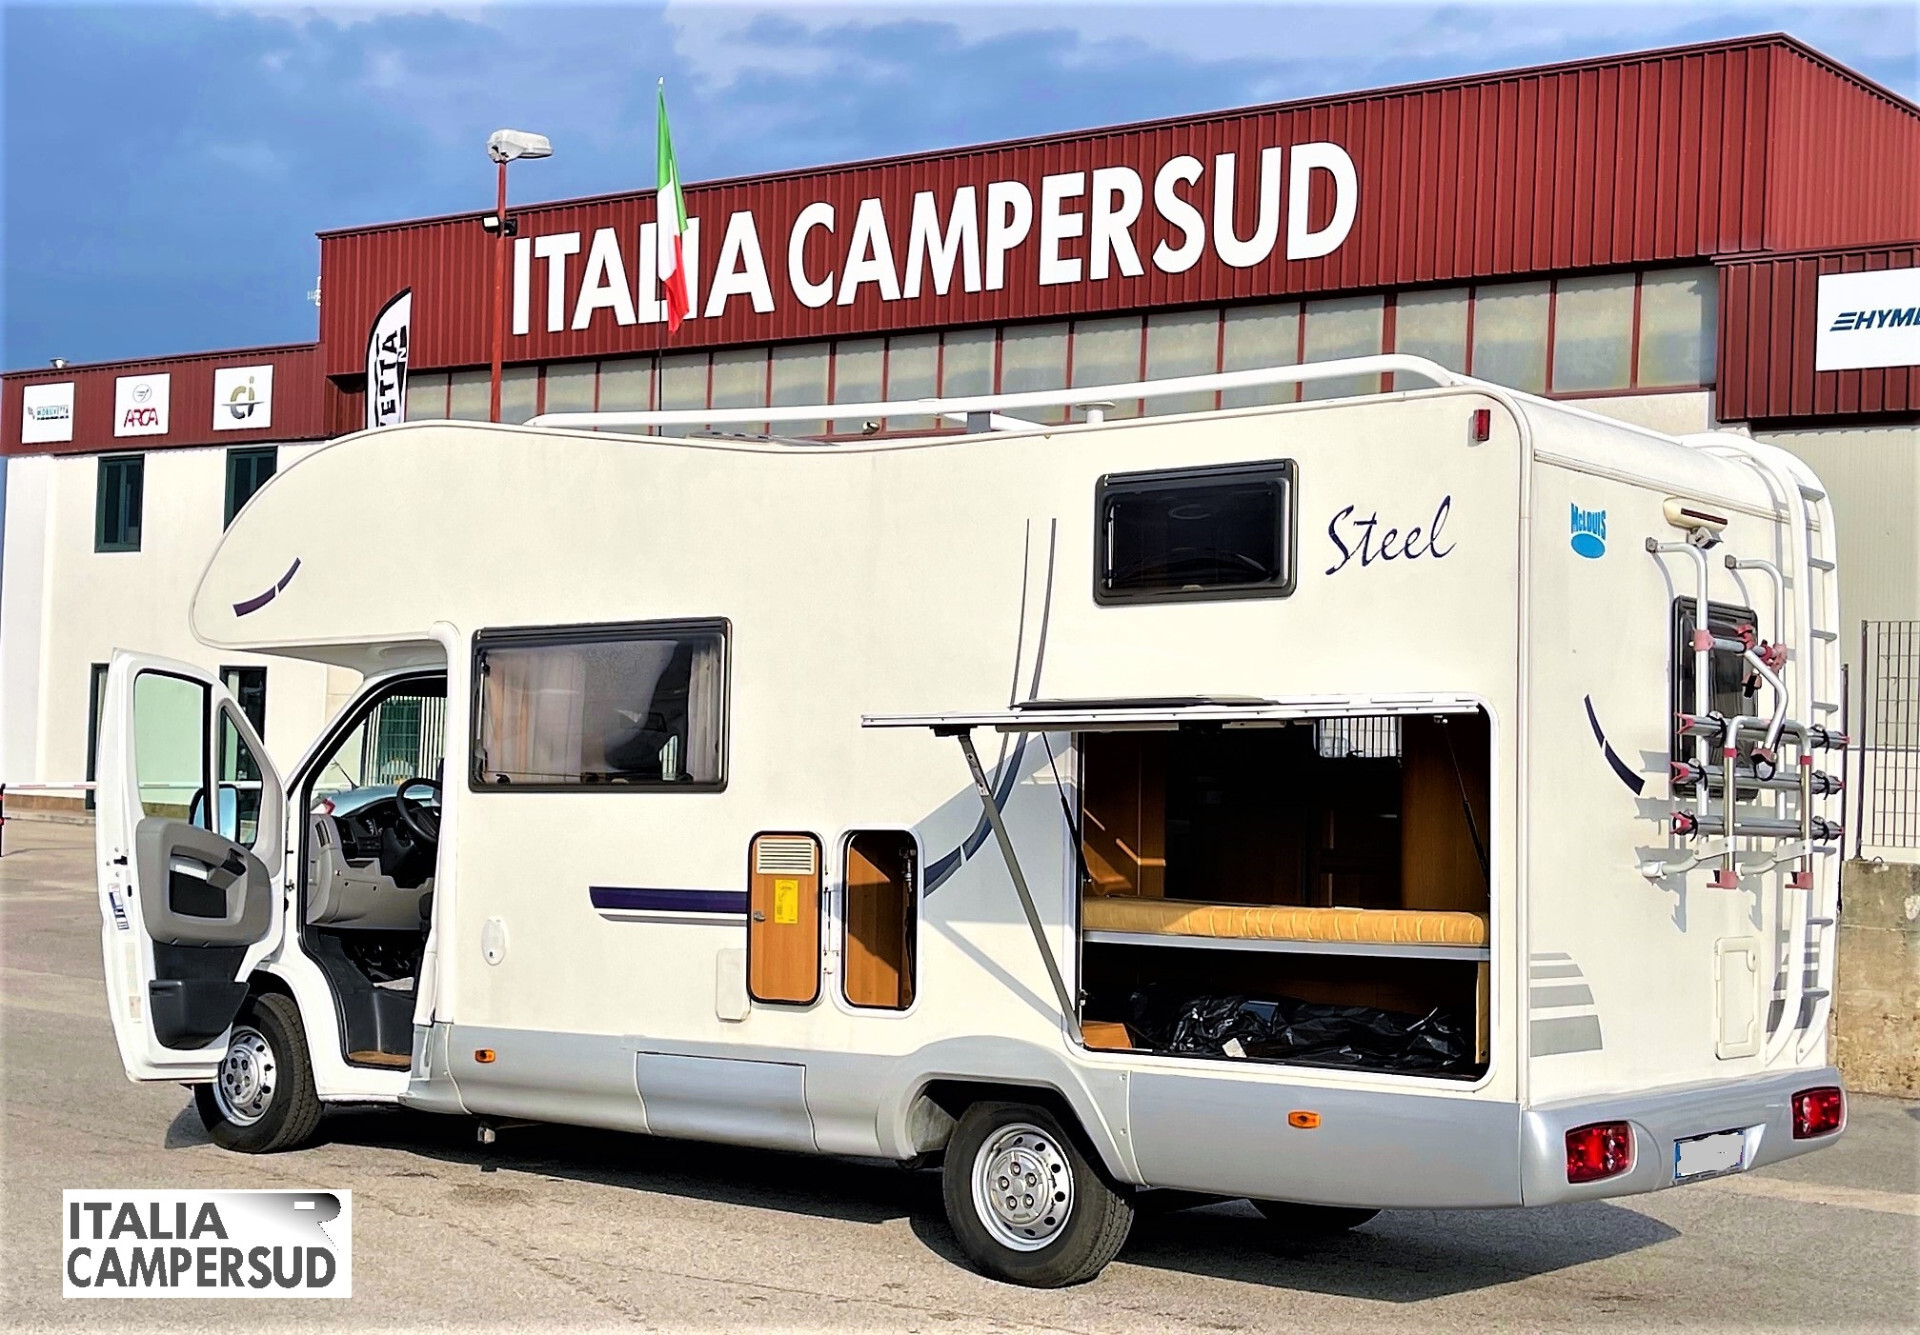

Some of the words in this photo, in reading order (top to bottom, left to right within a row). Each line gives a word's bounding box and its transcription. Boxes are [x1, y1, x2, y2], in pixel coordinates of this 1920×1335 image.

[512, 210, 775, 335] ITALIA
[788, 141, 1358, 308] CAMPERSUD
[124, 408, 158, 428] ARCA
[1325, 495, 1457, 576] Steel
